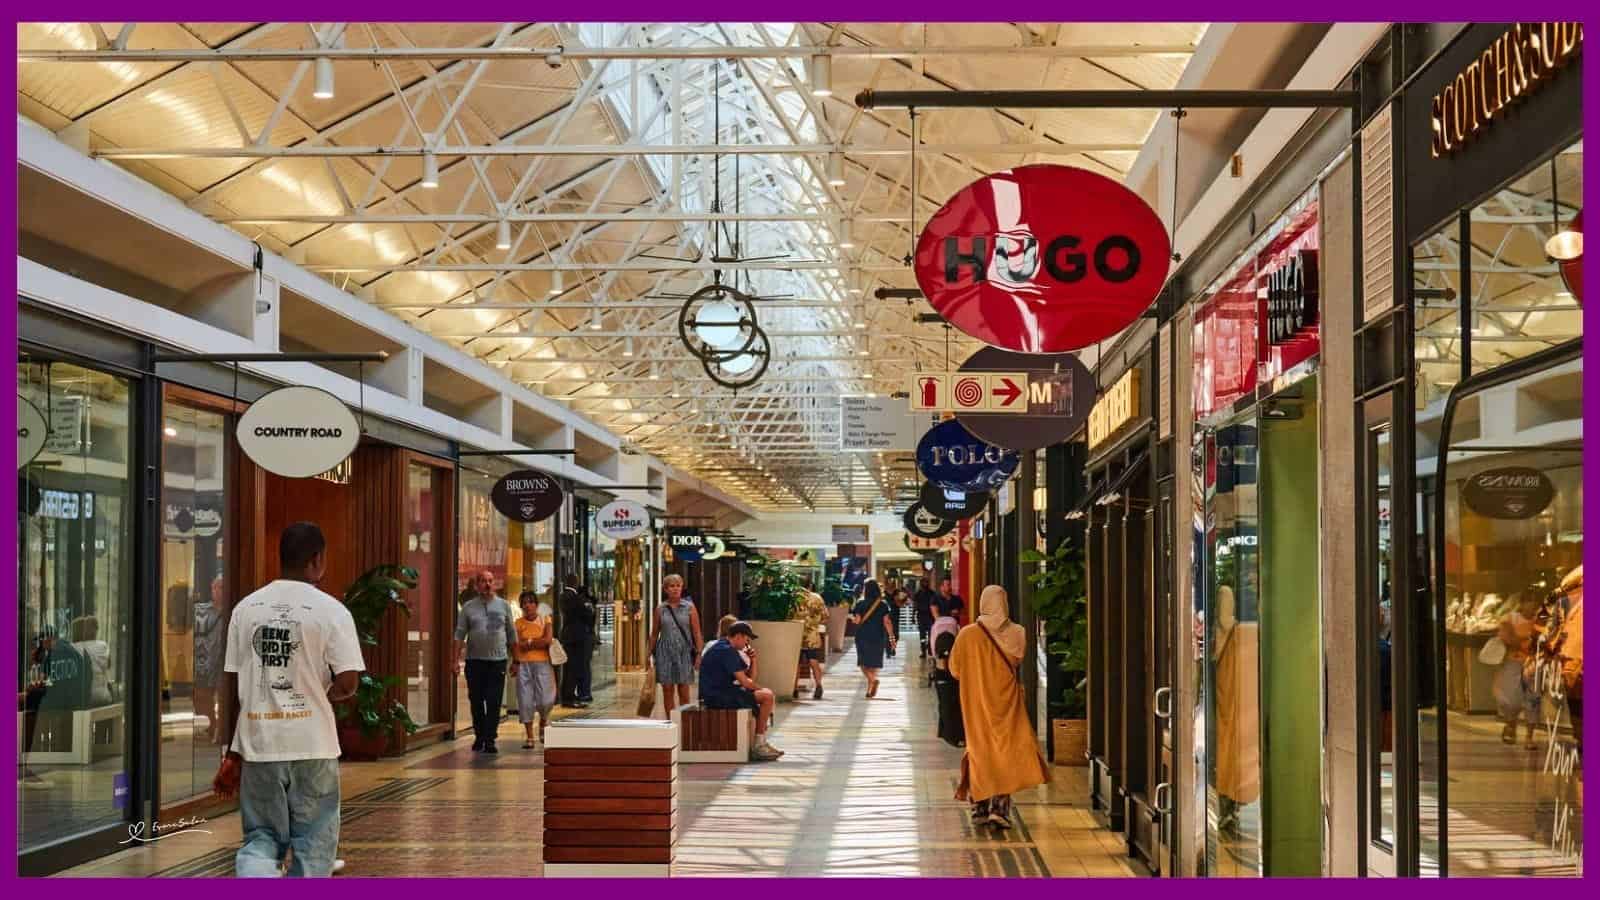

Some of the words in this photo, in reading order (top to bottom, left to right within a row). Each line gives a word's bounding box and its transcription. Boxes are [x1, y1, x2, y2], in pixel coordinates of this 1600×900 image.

[943, 234, 1141, 284] HUGO
[254, 426, 308, 438] COUNTRY
[310, 426, 342, 438] ROAD
[931, 445, 1004, 467] POLO
[505, 479, 549, 490] BROWNS
[602, 519, 642, 529] SUPERGA
[672, 535, 702, 545] DIOR
[262, 655, 290, 667] FIRST
[1543, 705, 1580, 783] Your
